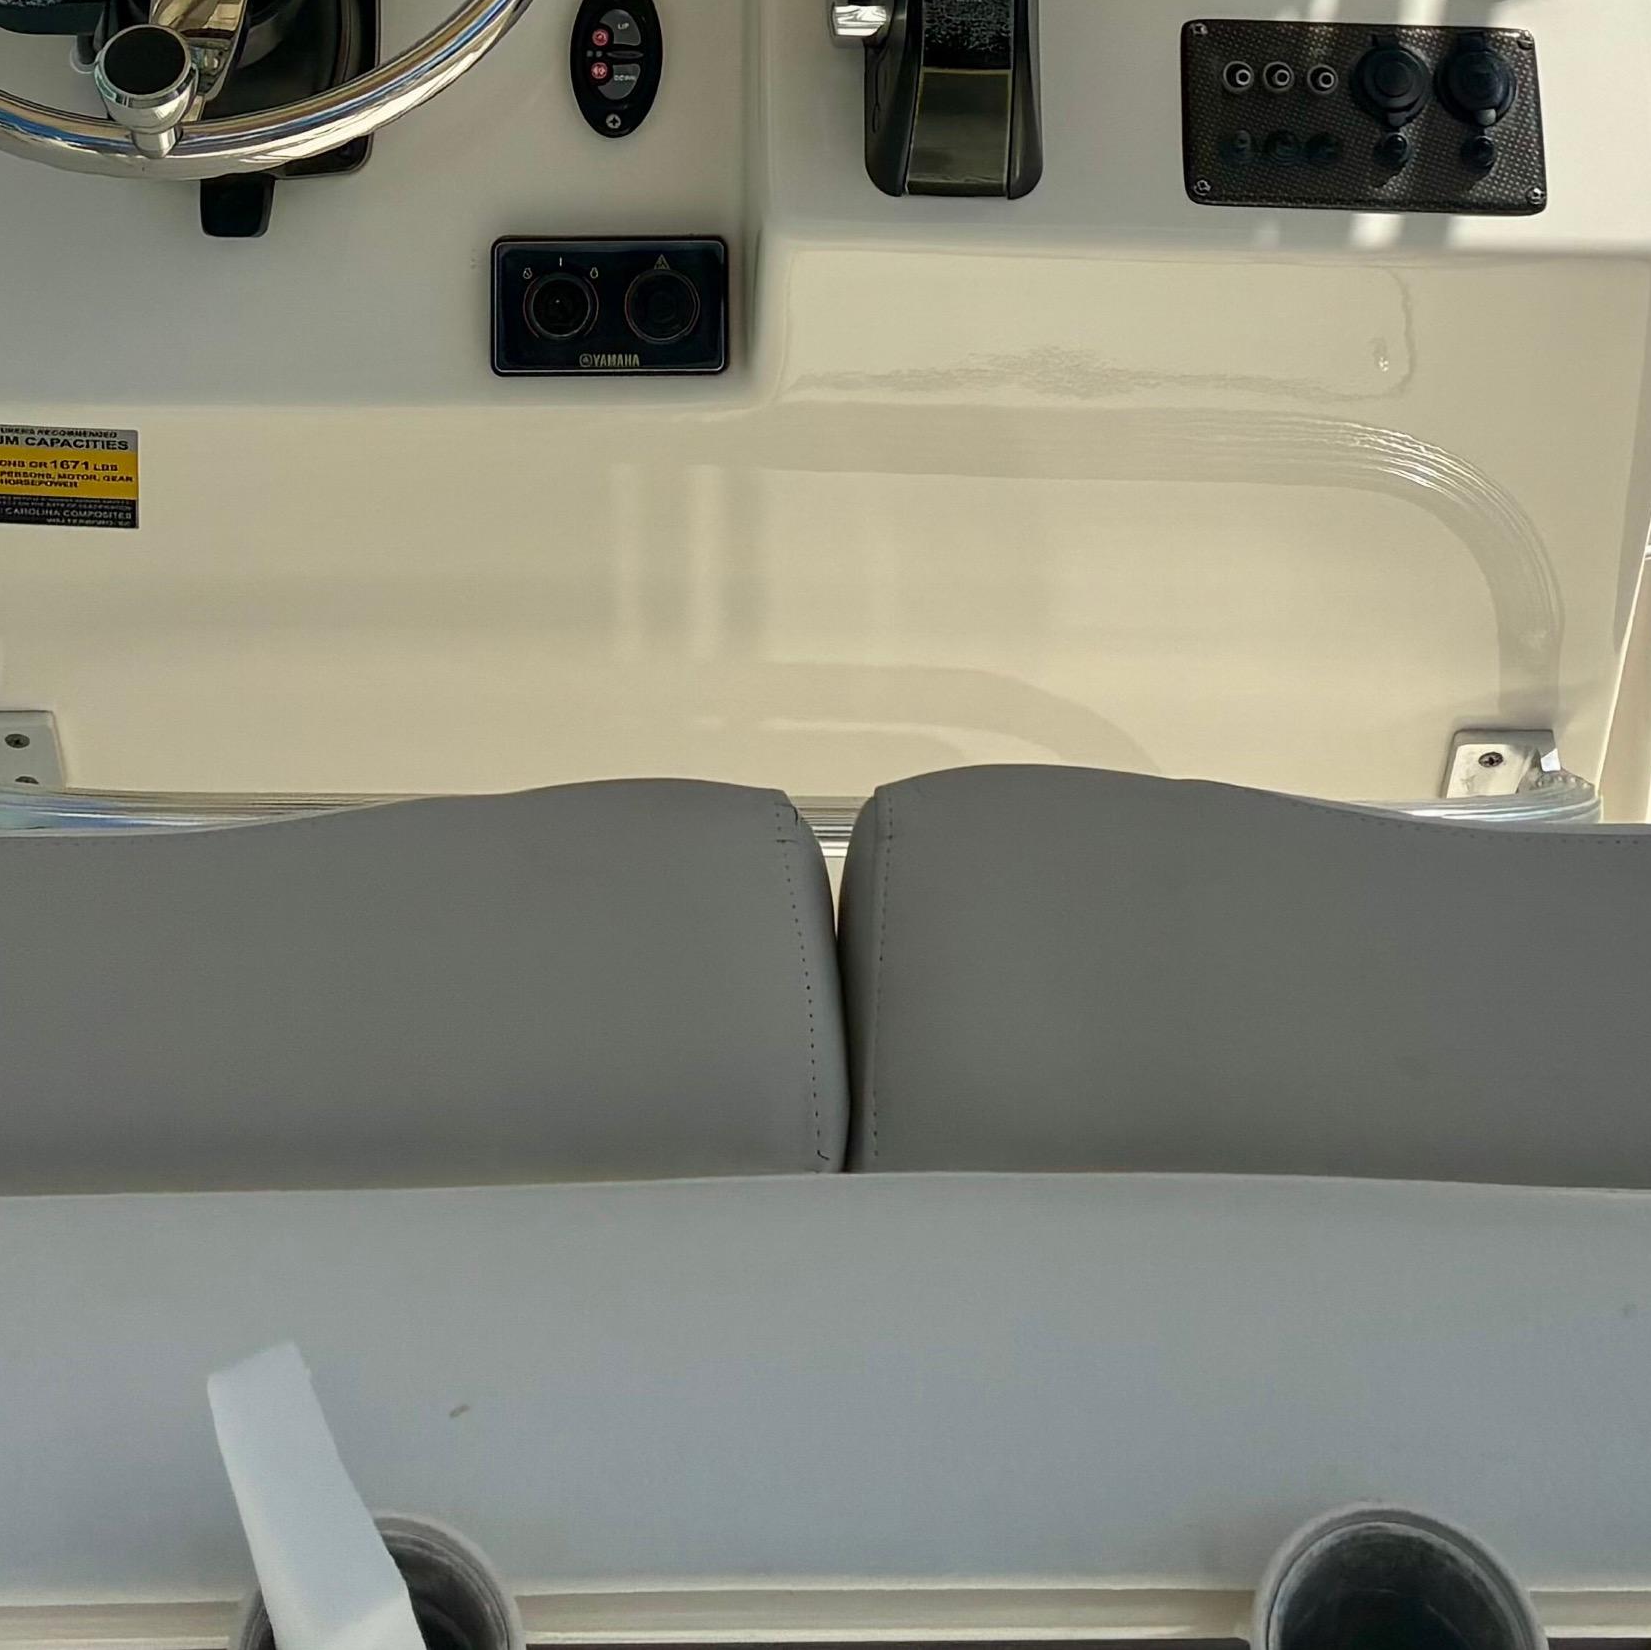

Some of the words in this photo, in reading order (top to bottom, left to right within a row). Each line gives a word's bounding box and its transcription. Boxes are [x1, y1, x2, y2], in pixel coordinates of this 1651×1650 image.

[617, 22, 630, 30] UP
[592, 353, 640, 368] YAMAHA
[24, 435, 130, 451] CAPACITIES
[28, 459, 48, 469] OR
[49, 458, 91, 471] 1671
[0, 477, 79, 488] HORSEPOWER
[102, 475, 134, 483] GEAR
[5, 506, 61, 518] CAROLINA
[62, 509, 132, 520] COMPOSITES
